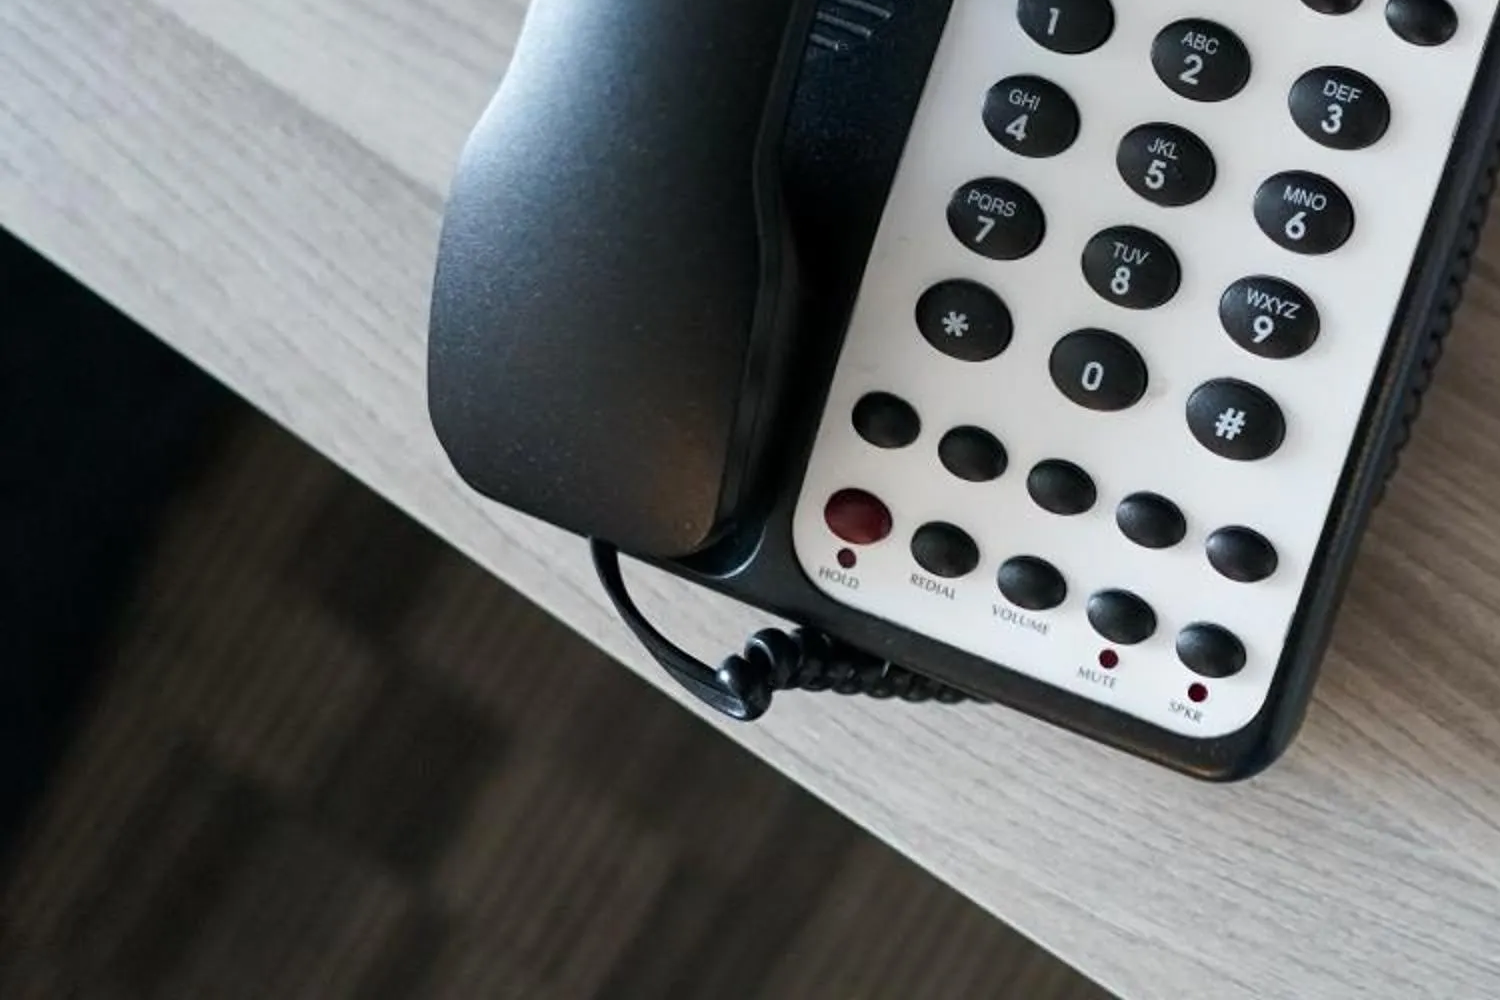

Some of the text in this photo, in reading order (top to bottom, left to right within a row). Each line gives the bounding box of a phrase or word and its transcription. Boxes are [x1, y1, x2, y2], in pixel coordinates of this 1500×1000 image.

[1047, 8, 1060, 36] 1
[1180, 30, 1220, 56] ABC
[1180, 54, 1204, 86] 2
[1008, 87, 1042, 110] GHI
[1322, 79, 1362, 104] DEF
[1004, 114, 1028, 143] 4
[1321, 103, 1344, 135] 3
[1146, 136, 1180, 161] JKL
[1144, 159, 1168, 190] 5
[966, 190, 1018, 218] PQRS
[1282, 184, 1328, 212] MNO
[974, 216, 996, 244] 7
[1284, 210, 1307, 241] 6
[1112, 241, 1150, 266] TUV
[1110, 266, 1132, 296] 8
[1246, 287, 1301, 320] WXYZ
[1252, 314, 1276, 344] 9
[1081, 360, 1105, 392] 0
[1214, 407, 1247, 441] #
[817, 565, 860, 591] HOLD
[909, 572, 956, 601] REDIAL
[991, 604, 1051, 635] VOLUME
[1076, 664, 1118, 690] MUTE
[1167, 700, 1204, 724] SPKR
